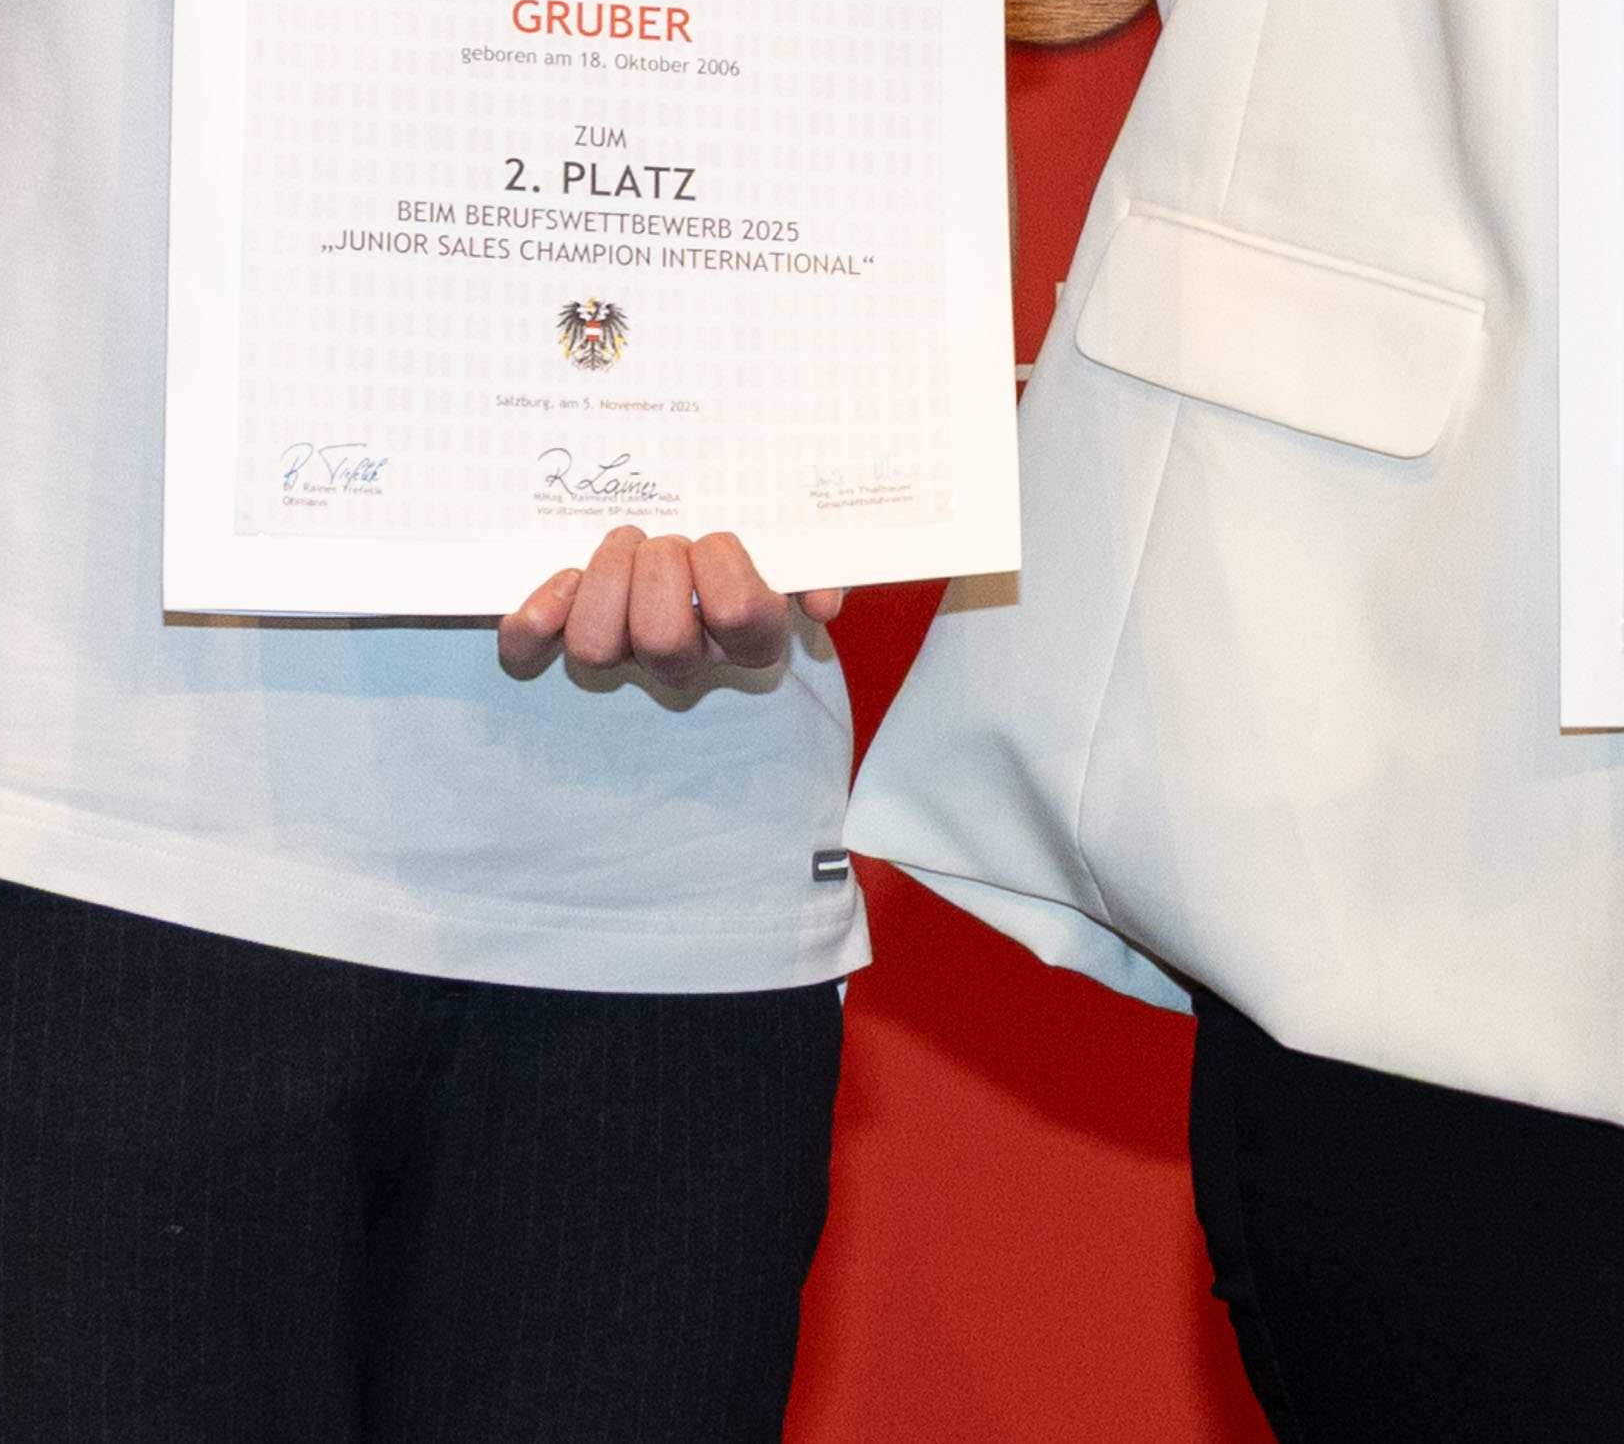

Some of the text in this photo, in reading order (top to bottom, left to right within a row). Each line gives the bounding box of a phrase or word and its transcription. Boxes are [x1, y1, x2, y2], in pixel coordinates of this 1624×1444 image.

[461, 45, 740, 77] geboren am 18. Oktober 2006
[575, 125, 627, 150] ZUM
[505, 157, 696, 202] 2. PLATZ
[398, 200, 799, 243] BEIM BERUFSWETTBEWERB 2025
[438, 234, 510, 260] SALES
[520, 239, 650, 267] CHAMPION
